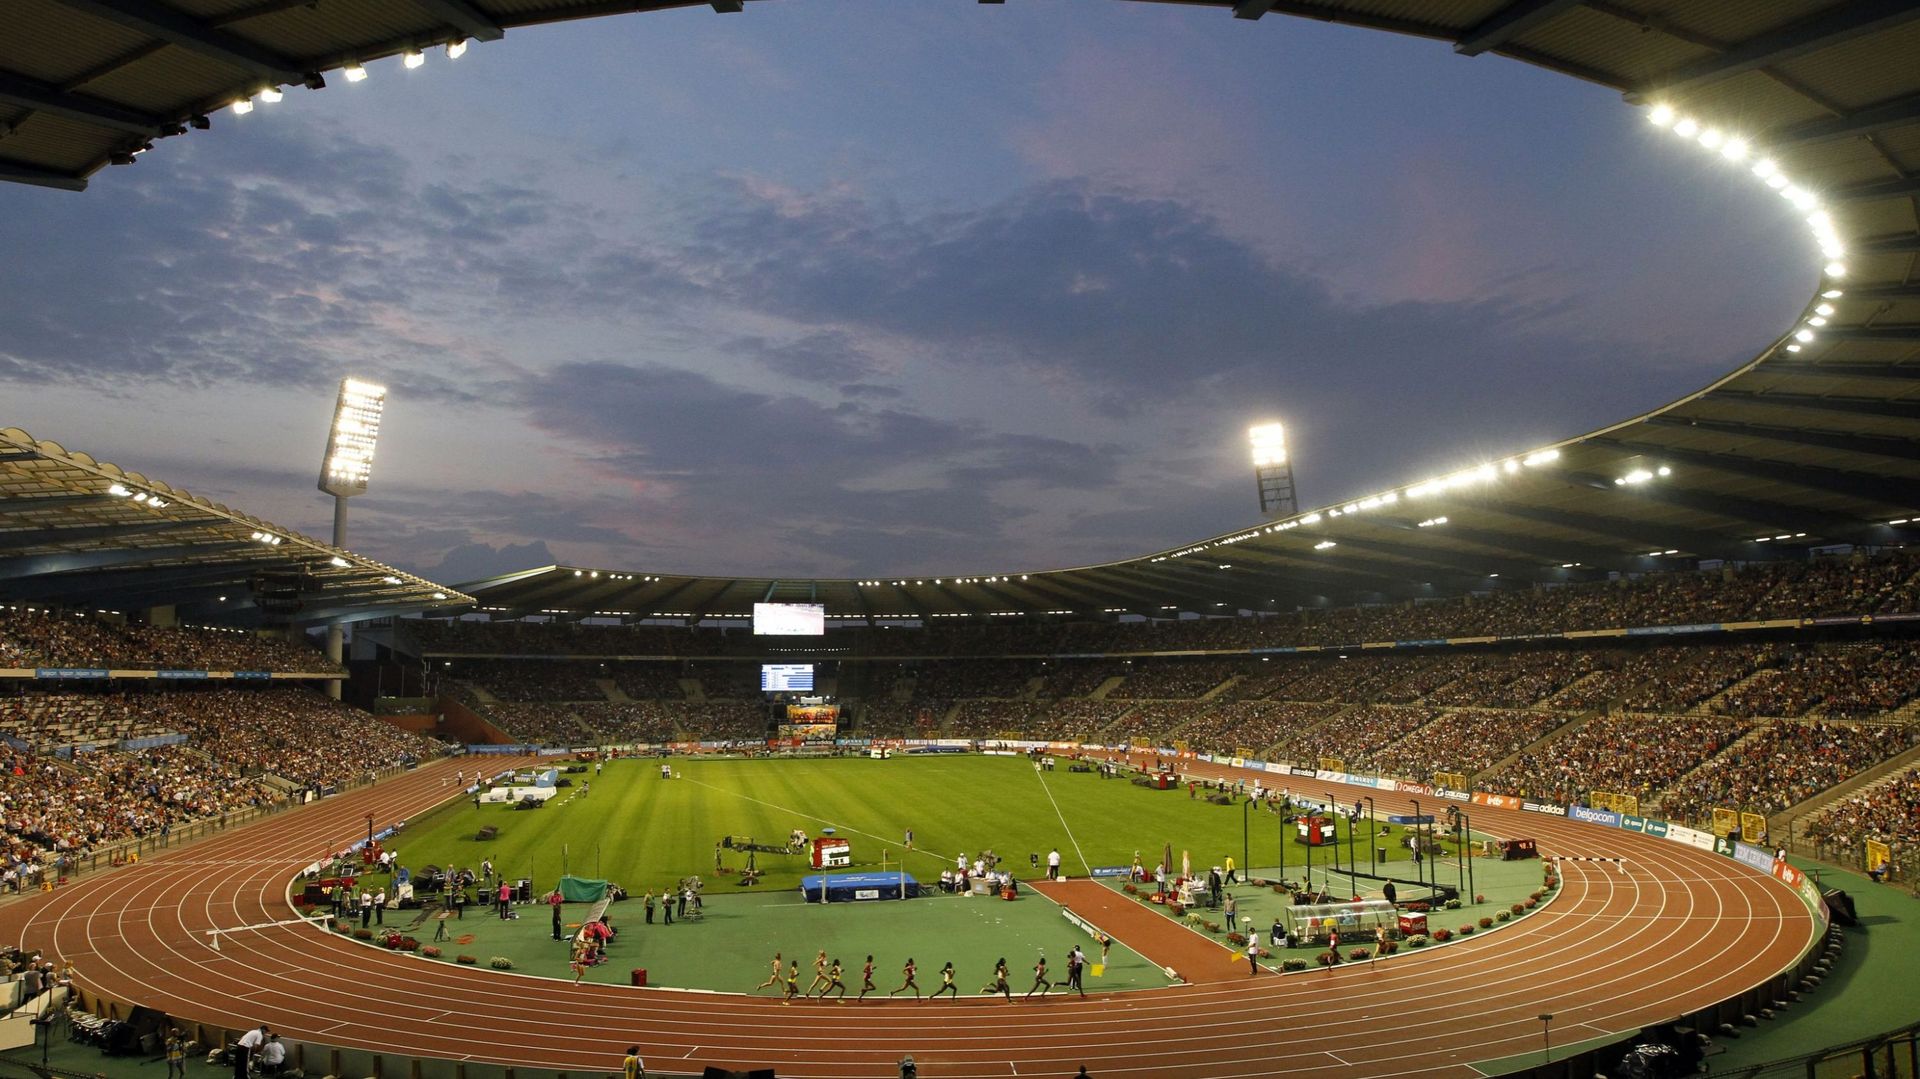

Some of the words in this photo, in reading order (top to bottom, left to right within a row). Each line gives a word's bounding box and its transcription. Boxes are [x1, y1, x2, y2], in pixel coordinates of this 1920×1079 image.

[1402, 784, 1424, 794] OMEGA
[1539, 804, 1565, 816] adidas
[1576, 807, 1615, 824] belgacom
